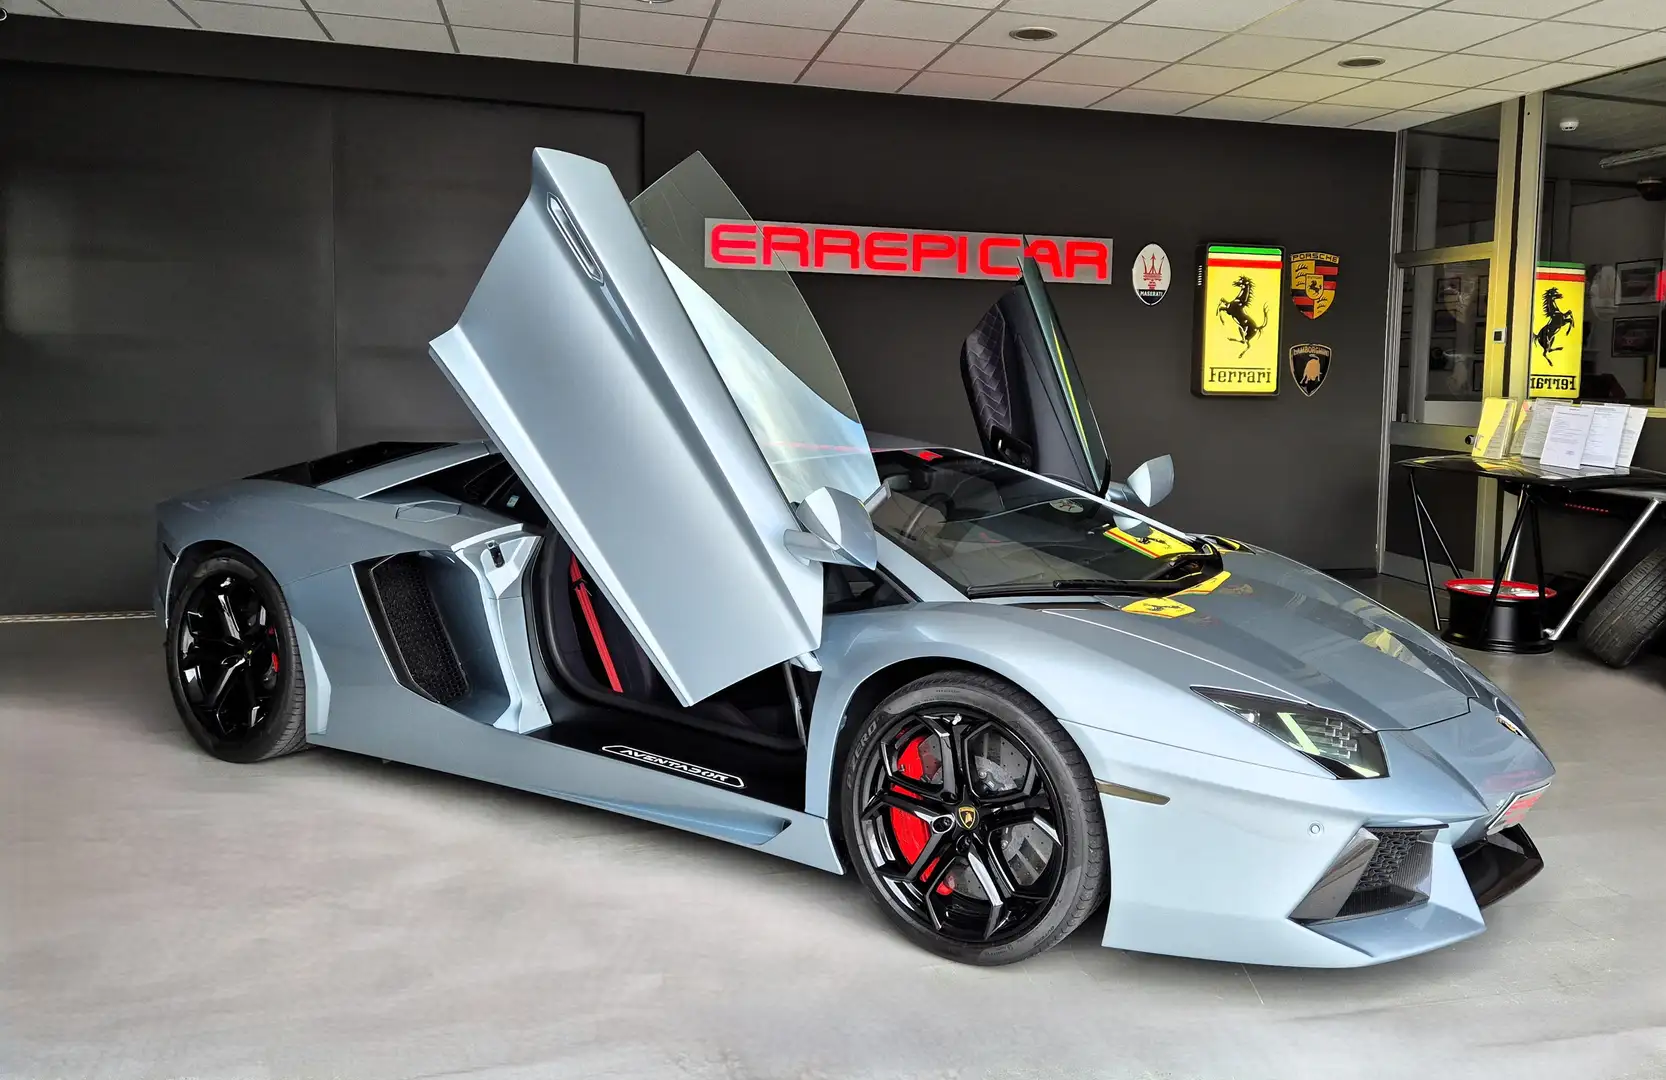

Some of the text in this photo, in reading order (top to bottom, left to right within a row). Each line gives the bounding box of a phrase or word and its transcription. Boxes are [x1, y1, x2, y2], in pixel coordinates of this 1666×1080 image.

[1291, 253, 1339, 263] PORSCHE
[1208, 366, 1272, 384] Ferrari
[620, 749, 729, 782] AVENTADOR
